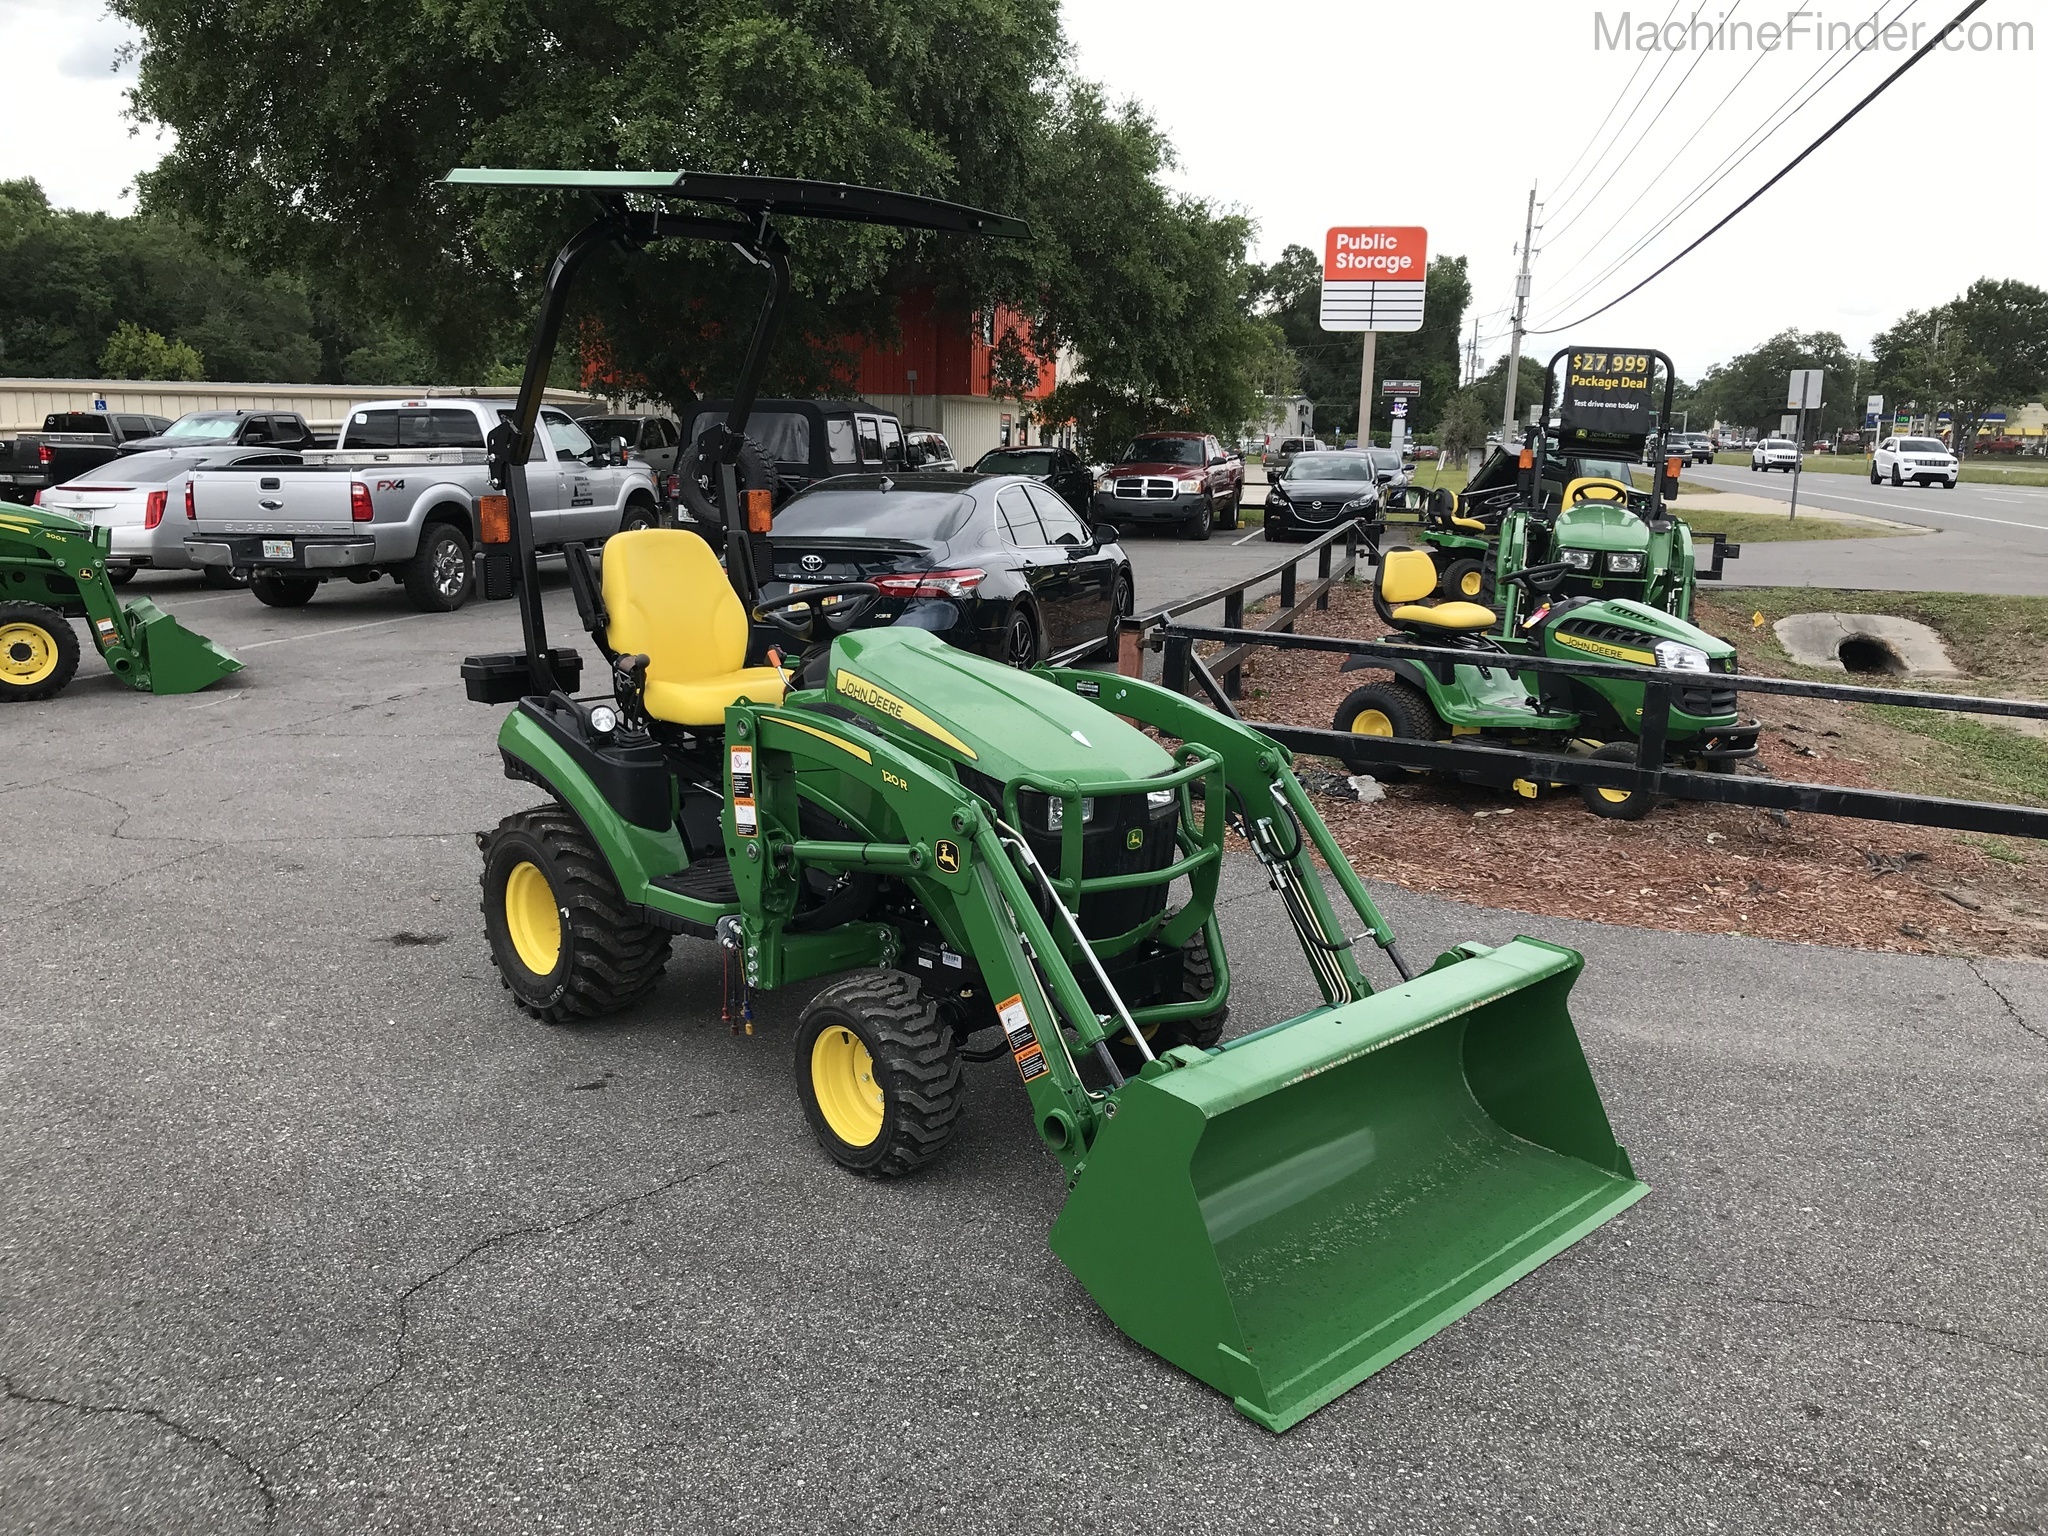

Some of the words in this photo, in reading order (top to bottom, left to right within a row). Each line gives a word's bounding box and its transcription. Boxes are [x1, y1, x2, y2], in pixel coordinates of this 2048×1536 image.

[1336, 233, 1398, 250] Public
[1573, 354, 1647, 375] $27,999
[1571, 375, 1619, 390] Package
[1621, 377, 1647, 389] Deal
[1573, 399, 1587, 407] Test
[1587, 400, 1604, 408] drive
[1618, 402, 1640, 411] today!
[377, 479, 406, 491] FX4
[224, 523, 276, 532] SUPER
[285, 524, 326, 533] DUTY
[1566, 636, 1591, 651] JOHN
[1591, 643, 1624, 659] DEERE
[841, 678, 869, 701] JOHN
[868, 689, 904, 718] DEERE
